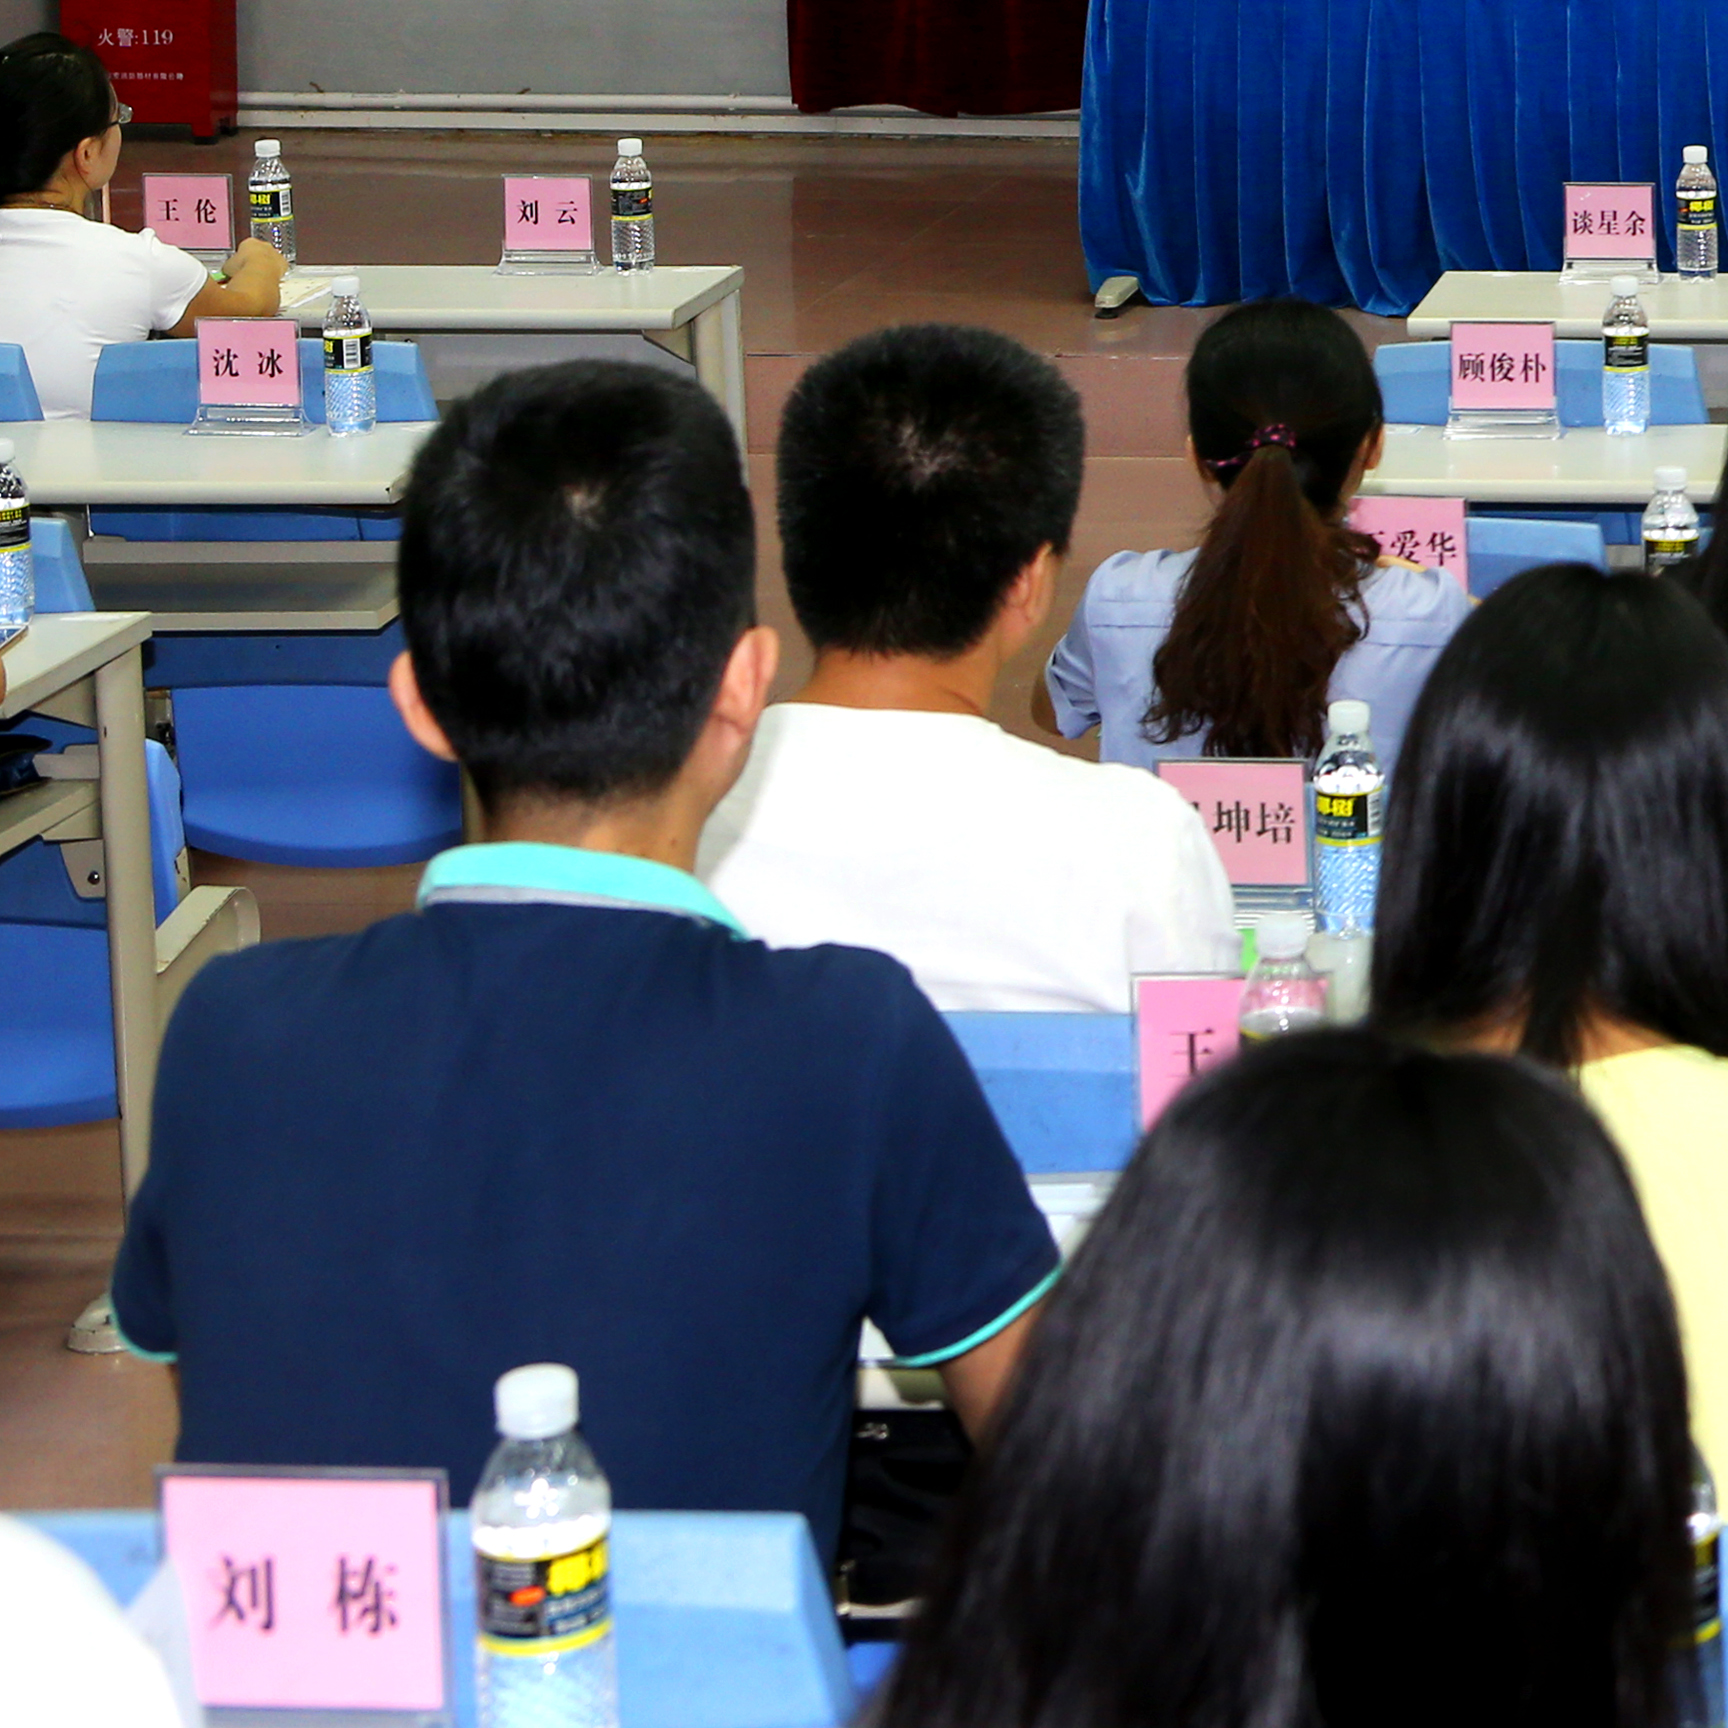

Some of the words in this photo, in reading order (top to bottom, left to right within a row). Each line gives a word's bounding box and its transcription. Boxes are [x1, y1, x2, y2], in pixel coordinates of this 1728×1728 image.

[157, 198, 217, 225] 王伦
[517, 199, 579, 225] 刘云
[1572, 209, 1647, 237] 谈星余
[212, 347, 285, 379] 沈冰
[1457, 352, 1548, 383] 顾俊朴
[210, 1555, 401, 1636] 刘栋
